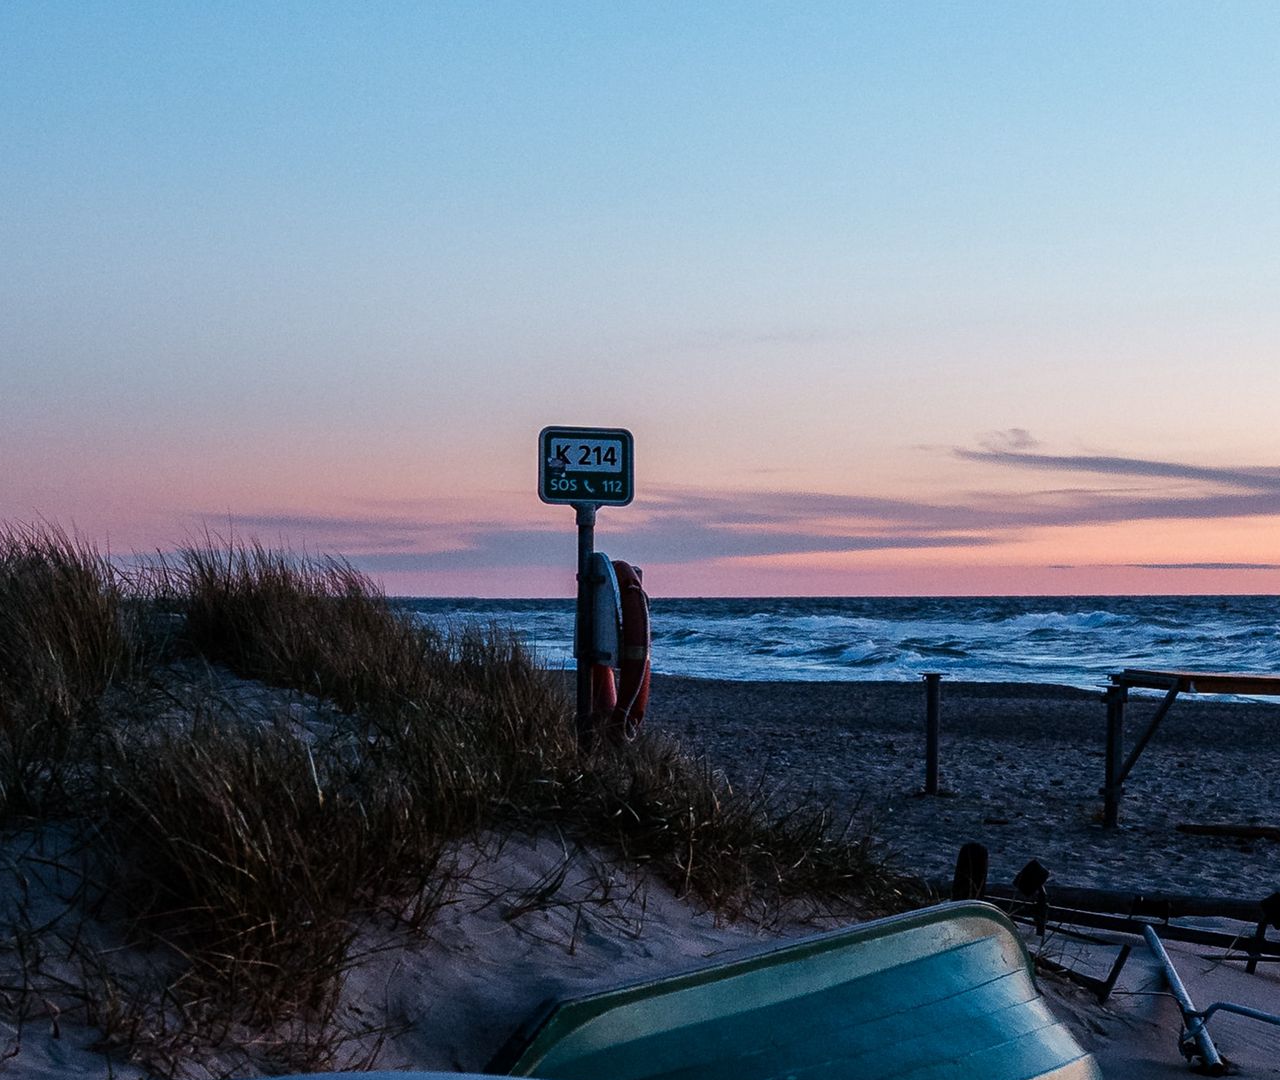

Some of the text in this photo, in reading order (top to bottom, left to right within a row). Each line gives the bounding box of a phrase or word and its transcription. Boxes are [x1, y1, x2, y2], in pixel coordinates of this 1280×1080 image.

[556, 445, 617, 466] K 214
[550, 479, 622, 492] SOS 112
